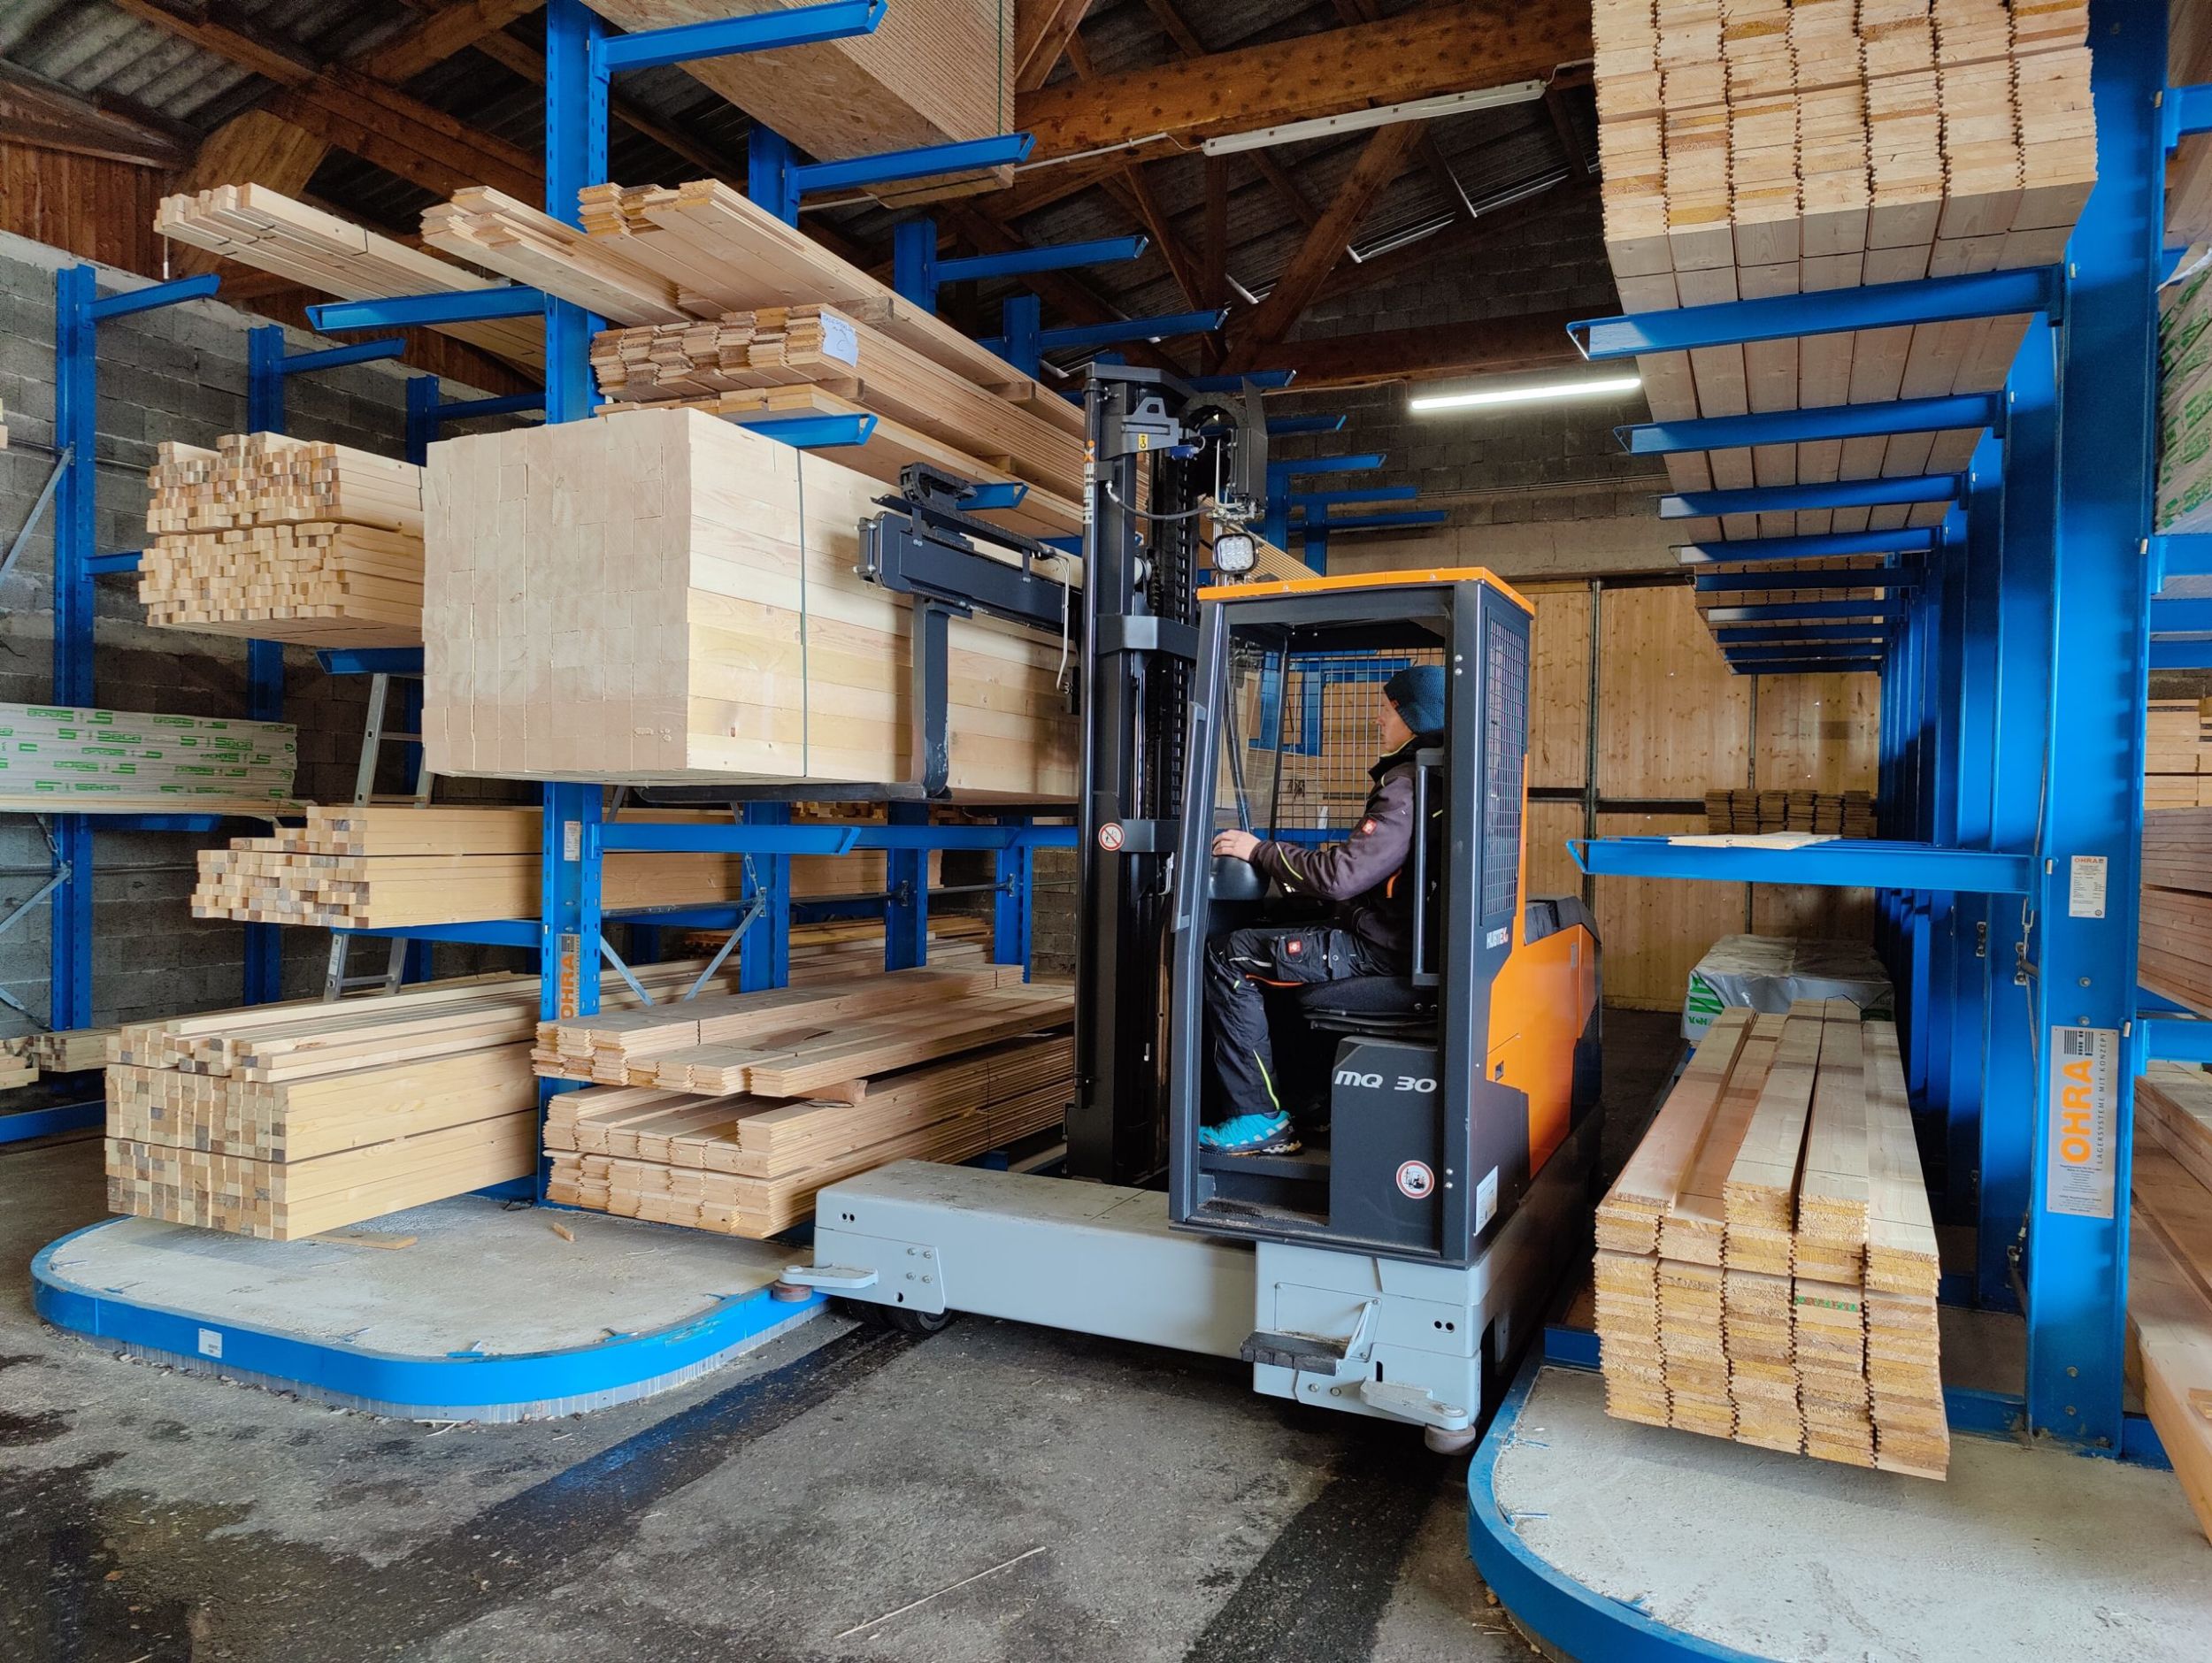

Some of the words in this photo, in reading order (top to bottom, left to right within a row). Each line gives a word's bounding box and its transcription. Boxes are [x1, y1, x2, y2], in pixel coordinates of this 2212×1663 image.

[561, 954, 574, 1019] OHRA
[1334, 1070, 1384, 1089] MQ
[1394, 1076, 1438, 1093] 30
[2060, 1061, 2093, 1163] OHRA
